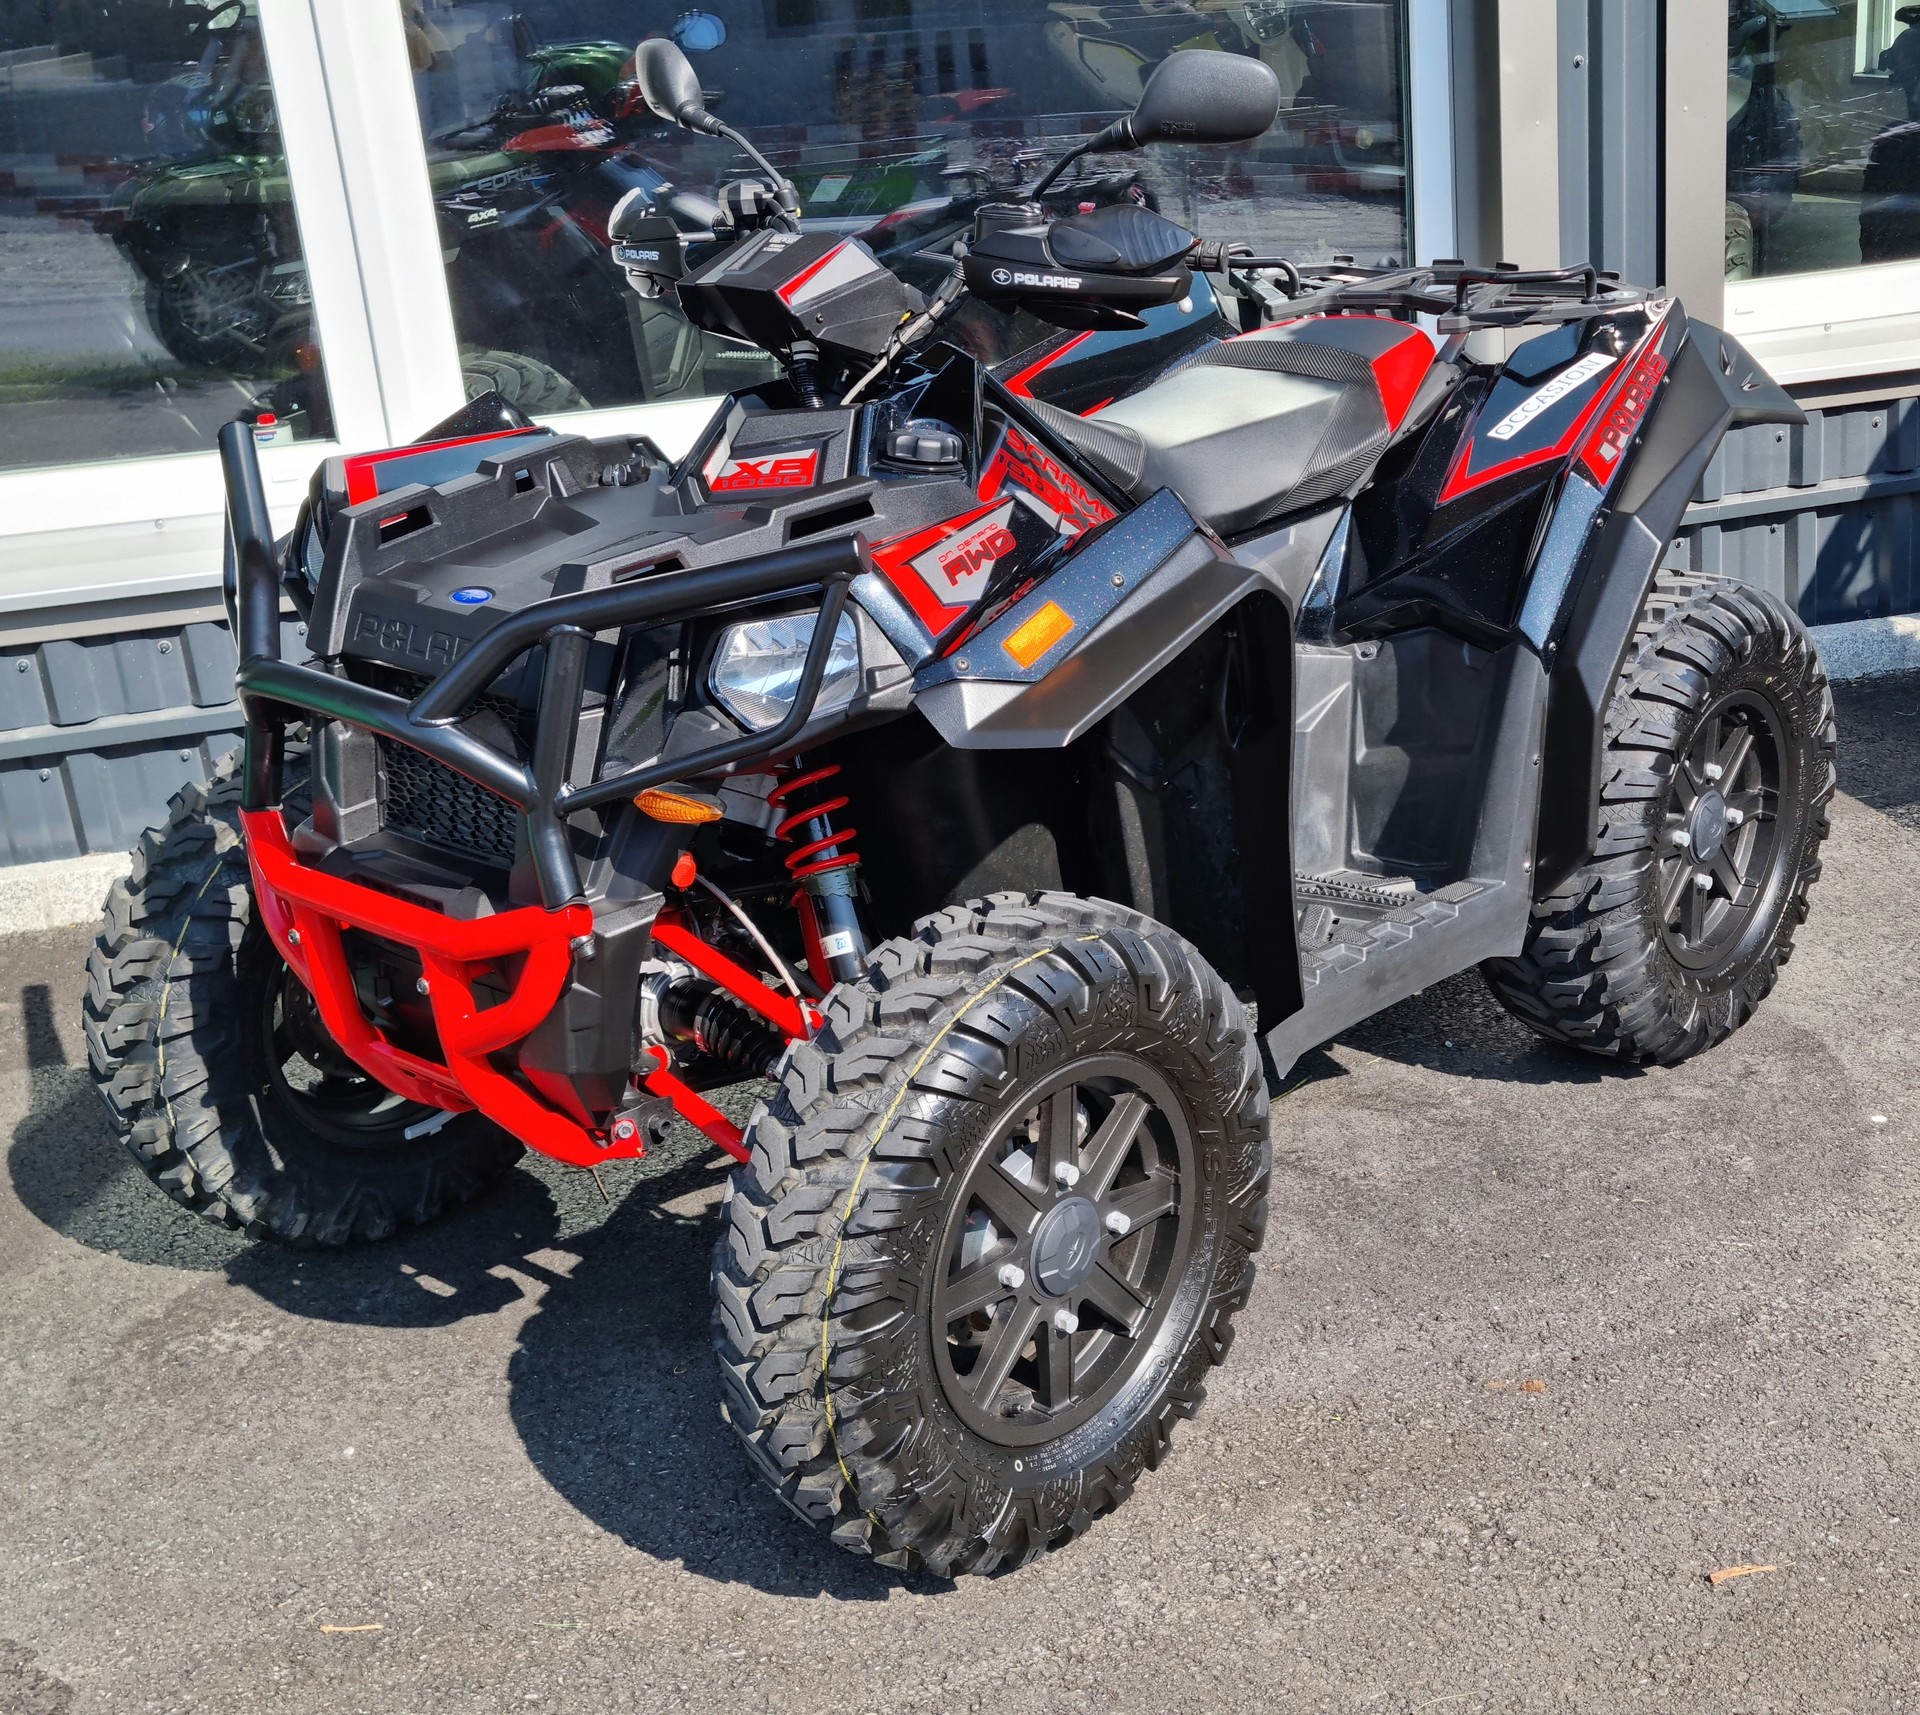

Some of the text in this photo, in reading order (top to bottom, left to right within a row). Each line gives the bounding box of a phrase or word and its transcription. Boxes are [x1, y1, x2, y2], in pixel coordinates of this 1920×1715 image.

[625, 249, 660, 261] POLARIS
[1014, 273, 1082, 290] POLARIS
[1494, 358, 1602, 437] OCCASION
[1601, 352, 1668, 452] POLARIS
[938, 522, 999, 563] ON DEMAND
[942, 528, 1017, 587] AWD
